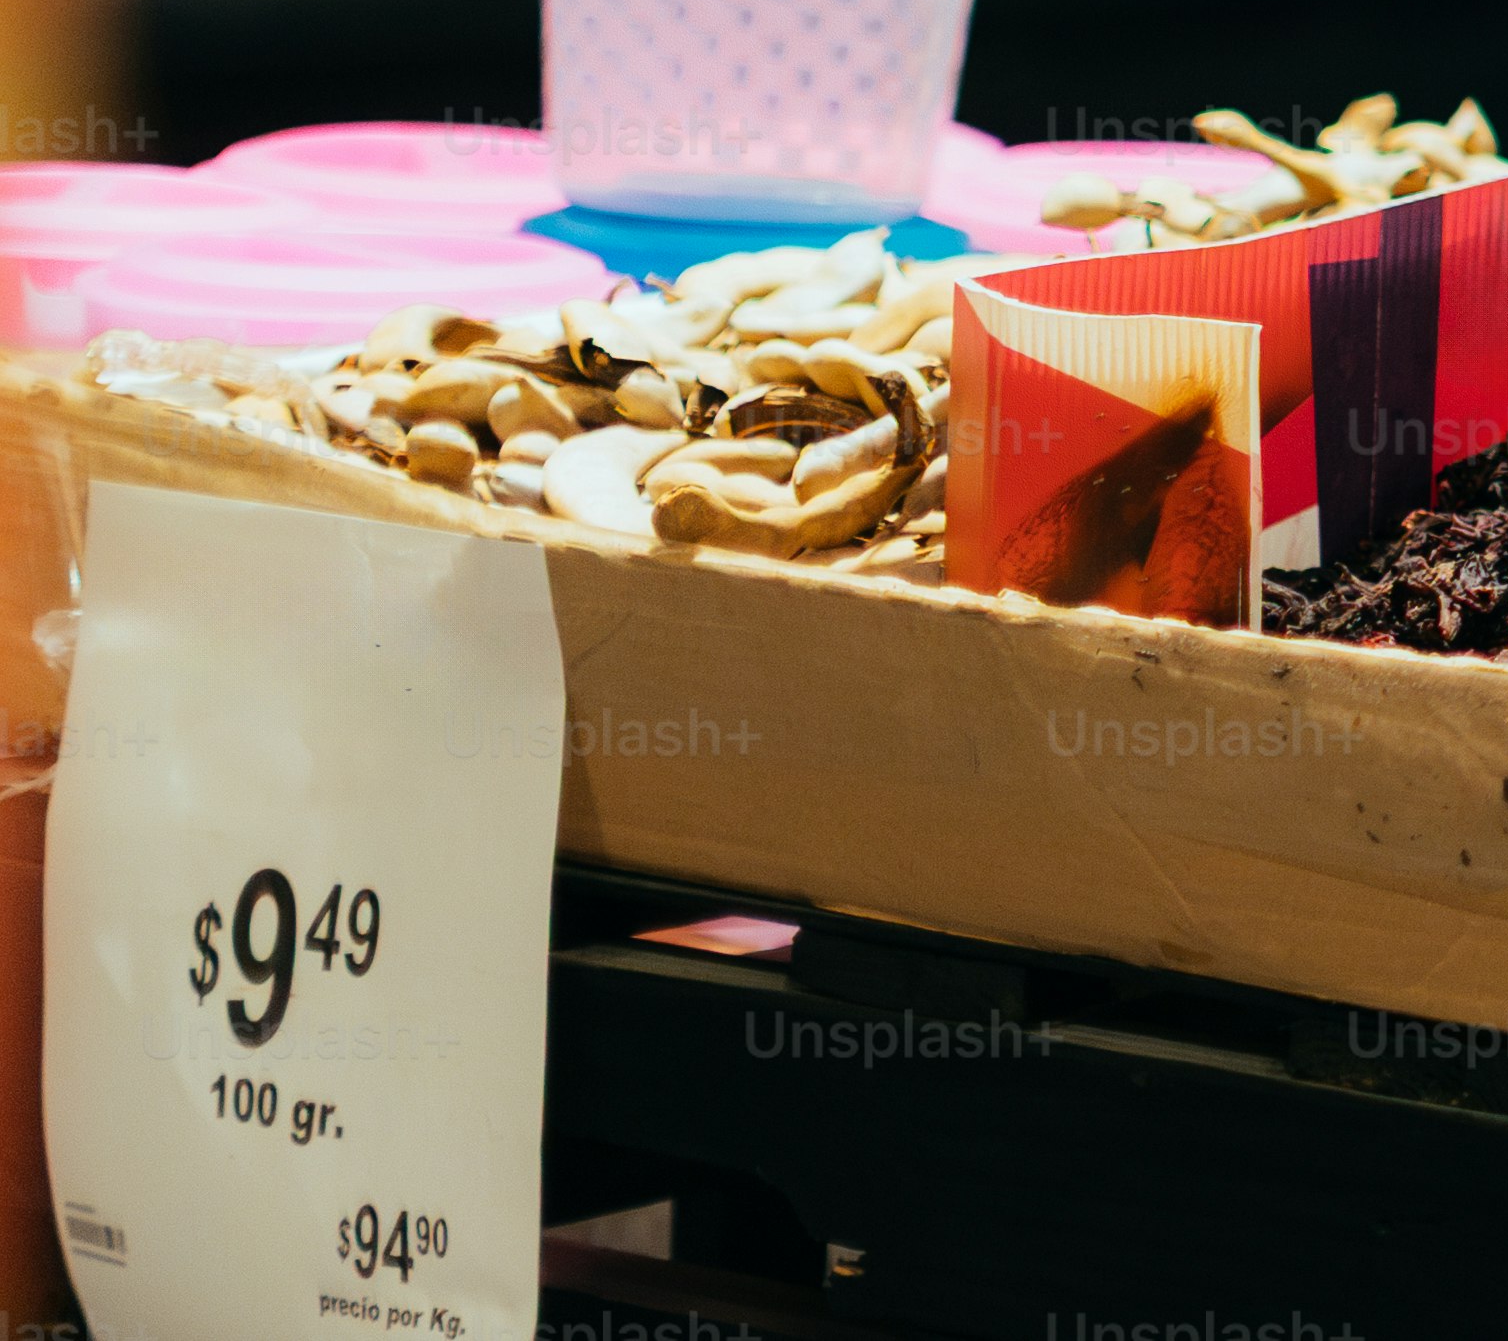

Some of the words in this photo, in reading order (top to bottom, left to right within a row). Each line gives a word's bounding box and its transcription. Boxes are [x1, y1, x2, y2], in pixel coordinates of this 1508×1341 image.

[211, 1074, 278, 1127] 100
[290, 1099, 343, 1145] gr.
[320, 1294, 380, 1321] precio
[386, 1307, 422, 1330] por
[430, 1307, 466, 1340] Kg.
